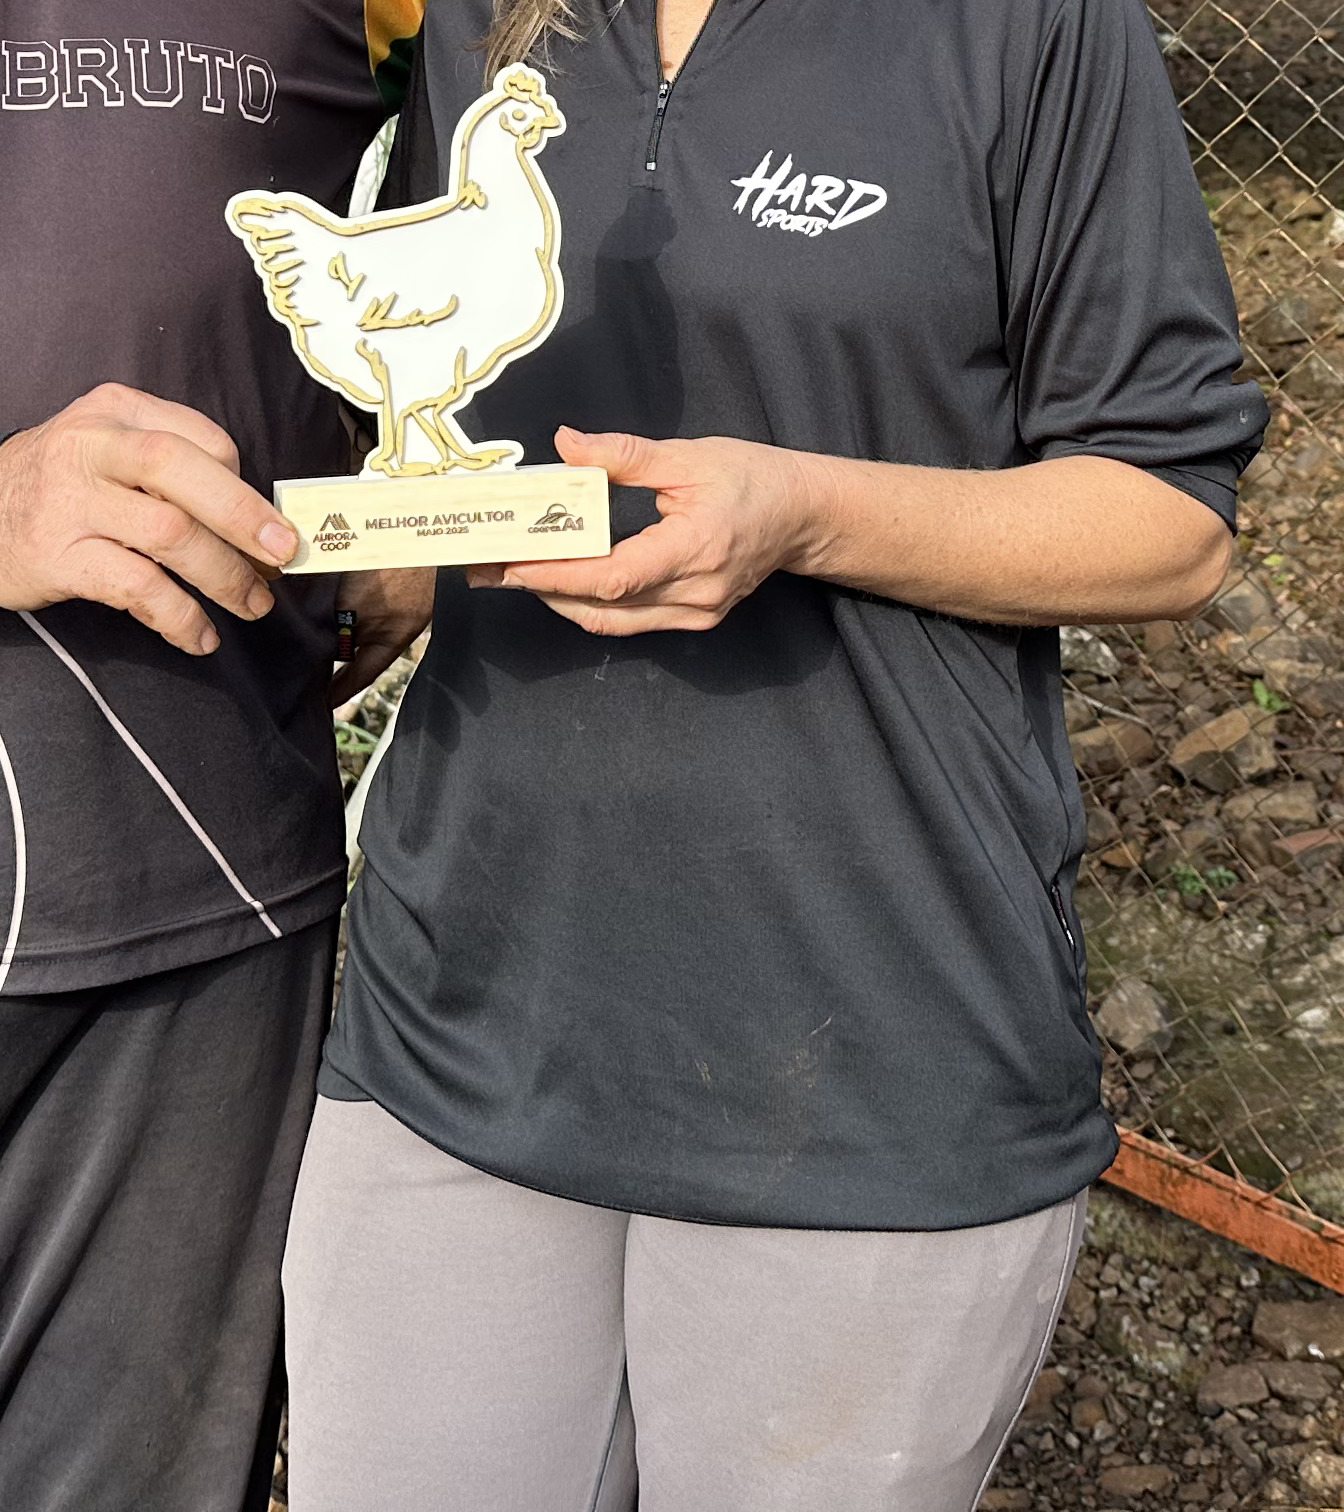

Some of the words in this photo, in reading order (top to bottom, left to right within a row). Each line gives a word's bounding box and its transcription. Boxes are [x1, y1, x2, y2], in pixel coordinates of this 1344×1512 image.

[1, 38, 278, 125] BRUTO
[730, 149, 888, 231] HARD
[756, 208, 829, 238] SPORTS
[365, 515, 429, 530] MELHOR
[432, 510, 516, 527] AVICULTOR
[313, 531, 359, 544] AURORA
[416, 527, 444, 537] MAIO
[446, 525, 470, 535] 2025
[320, 541, 352, 552] COOP
